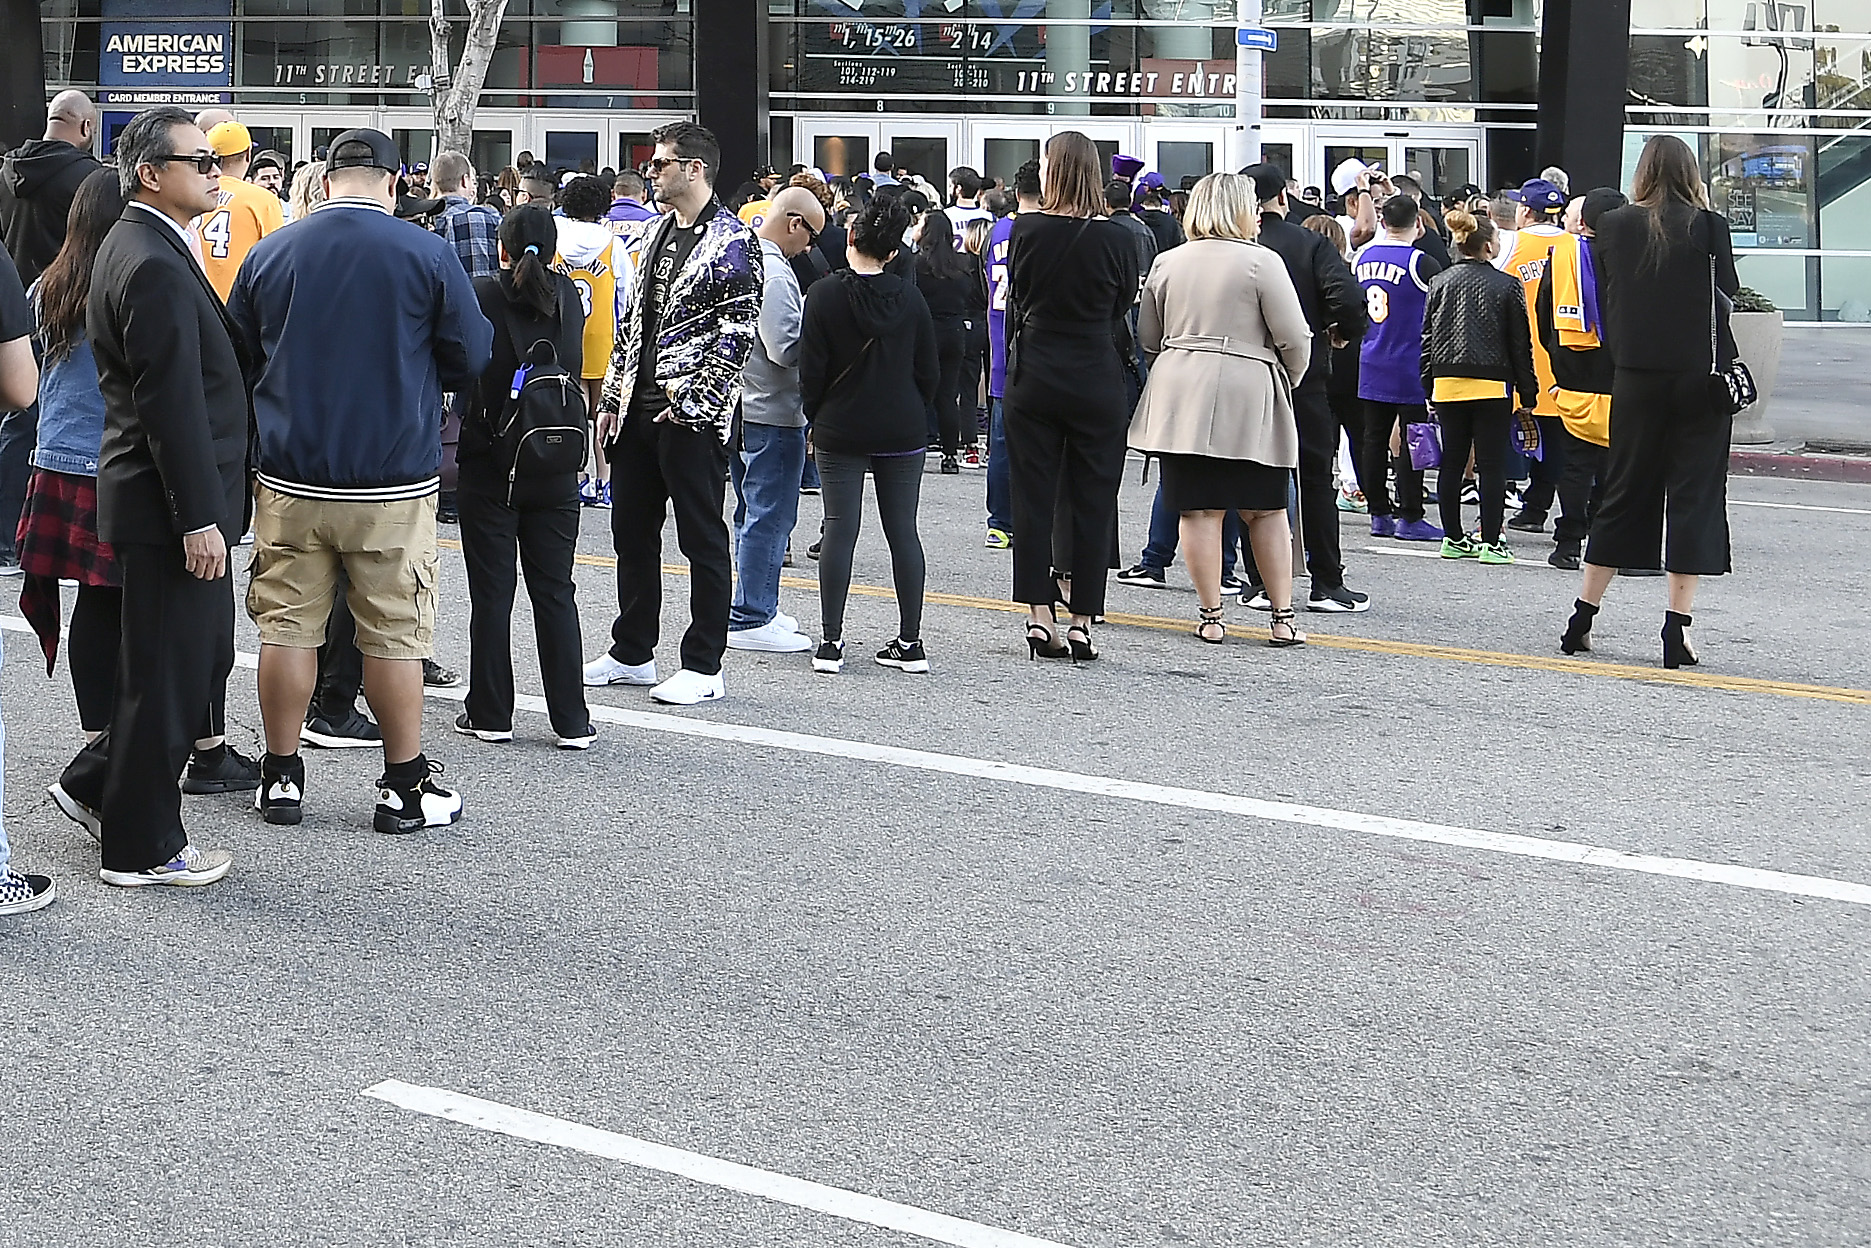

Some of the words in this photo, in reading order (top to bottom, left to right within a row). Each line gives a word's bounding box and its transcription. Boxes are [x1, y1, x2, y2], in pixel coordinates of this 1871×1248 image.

[106, 34, 223, 53] AMERICAN
[865, 28, 916, 48] 15-26
[122, 54, 225, 73] EXPRESS
[275, 64, 307, 84] 11TH
[315, 64, 396, 84] STREET
[1016, 71, 1055, 93] 11TH
[1064, 71, 1159, 94] STREET
[1171, 71, 1237, 95] ENTR
[107, 92, 132, 103] CARD
[133, 92, 172, 103] MEMBER
[172, 92, 221, 104] ENTRANCE
[299, 93, 306, 104] 5
[606, 96, 614, 108] 7
[876, 100, 884, 112] 8
[1047, 103, 1055, 114] 9
[1219, 105, 1230, 116] 10
[1728, 193, 1753, 208] SEE
[1728, 211, 1754, 225] SAY
[555, 258, 608, 277] BRNT
[1356, 261, 1407, 286] BRYANT
[1365, 284, 1390, 324] 8
